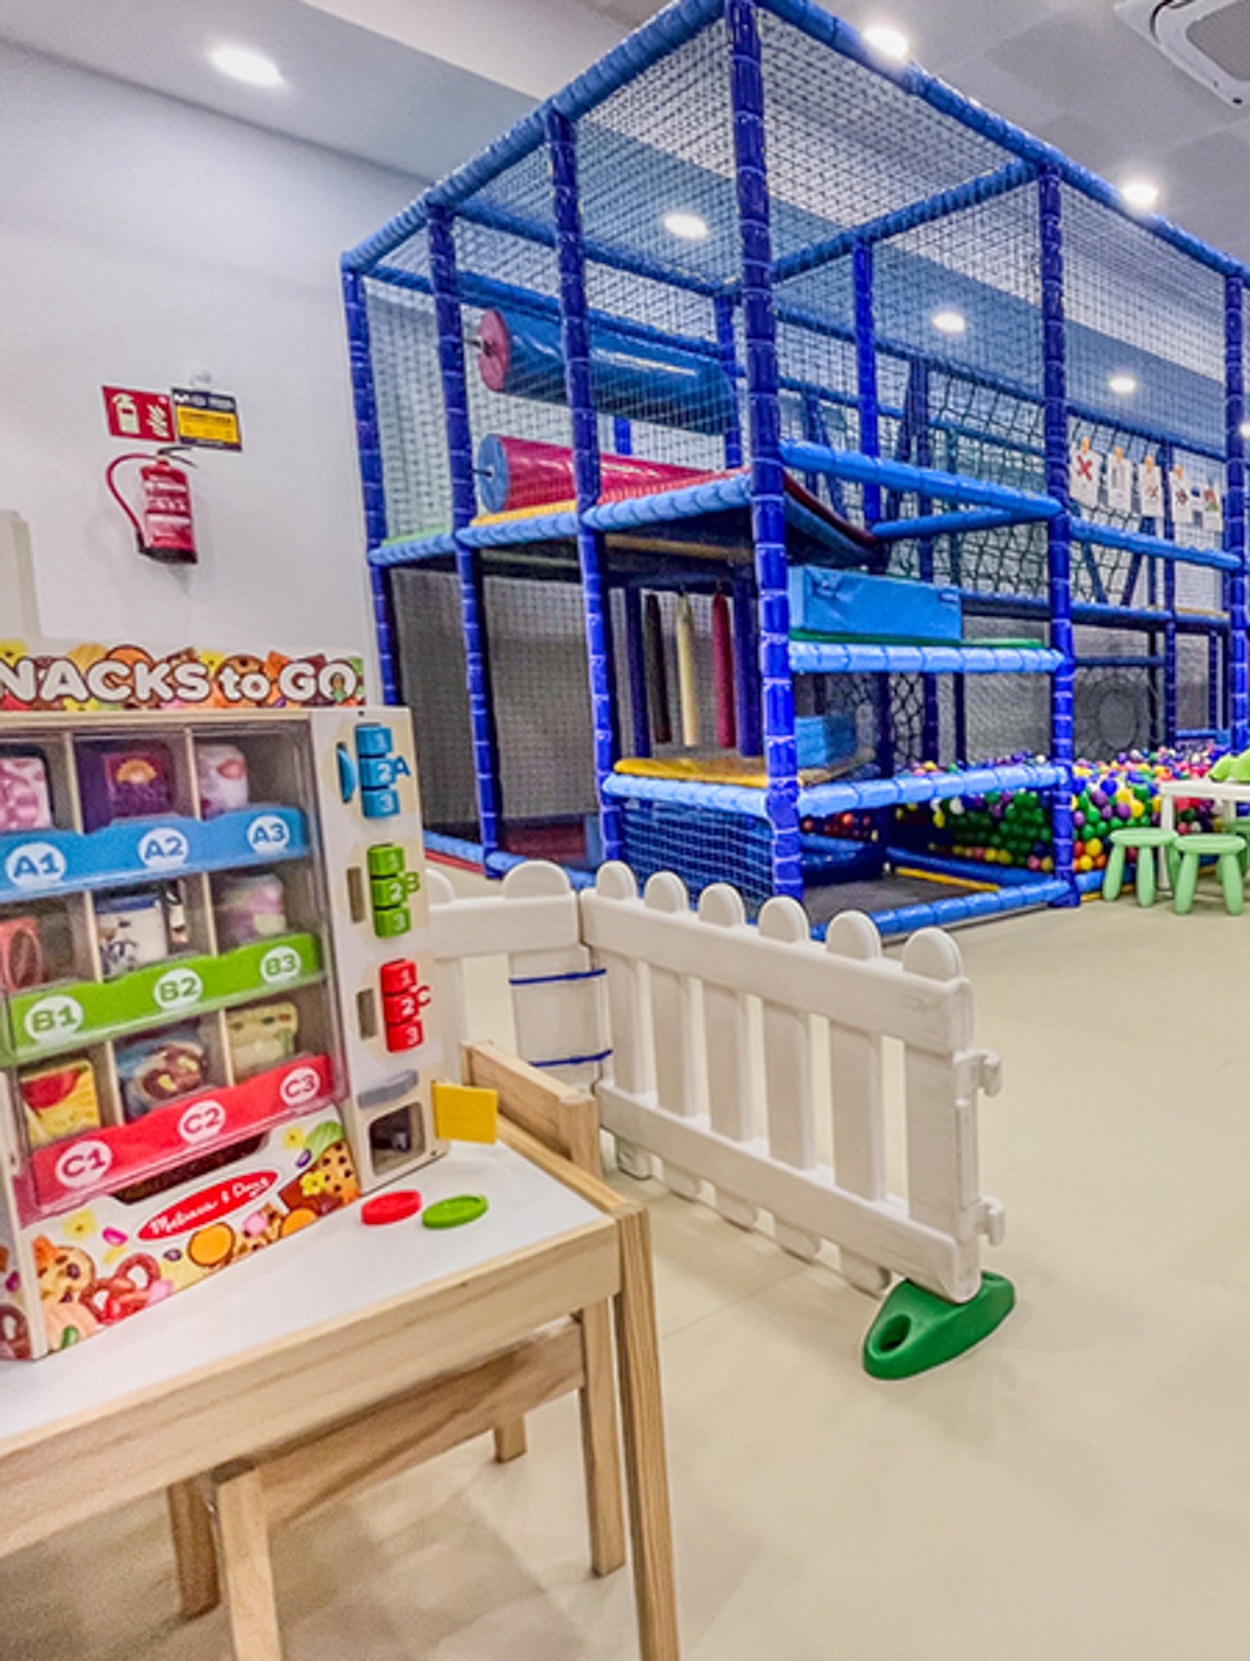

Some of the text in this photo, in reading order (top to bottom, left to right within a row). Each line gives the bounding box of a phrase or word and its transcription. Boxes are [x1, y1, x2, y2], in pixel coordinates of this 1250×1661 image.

[218, 671, 270, 700] to
[278, 659, 359, 701] GO
[377, 763, 392, 783] 2
[393, 755, 412, 777] A
[380, 795, 395, 812] 3
[13, 823, 287, 878] A1 A2 A3
[389, 882, 403, 900] 2
[30, 955, 297, 1033] B1 B2 B3
[401, 997, 415, 1016] 2
[406, 1027, 420, 1046] 3
[62, 1073, 317, 1180] C1 C2 C3
